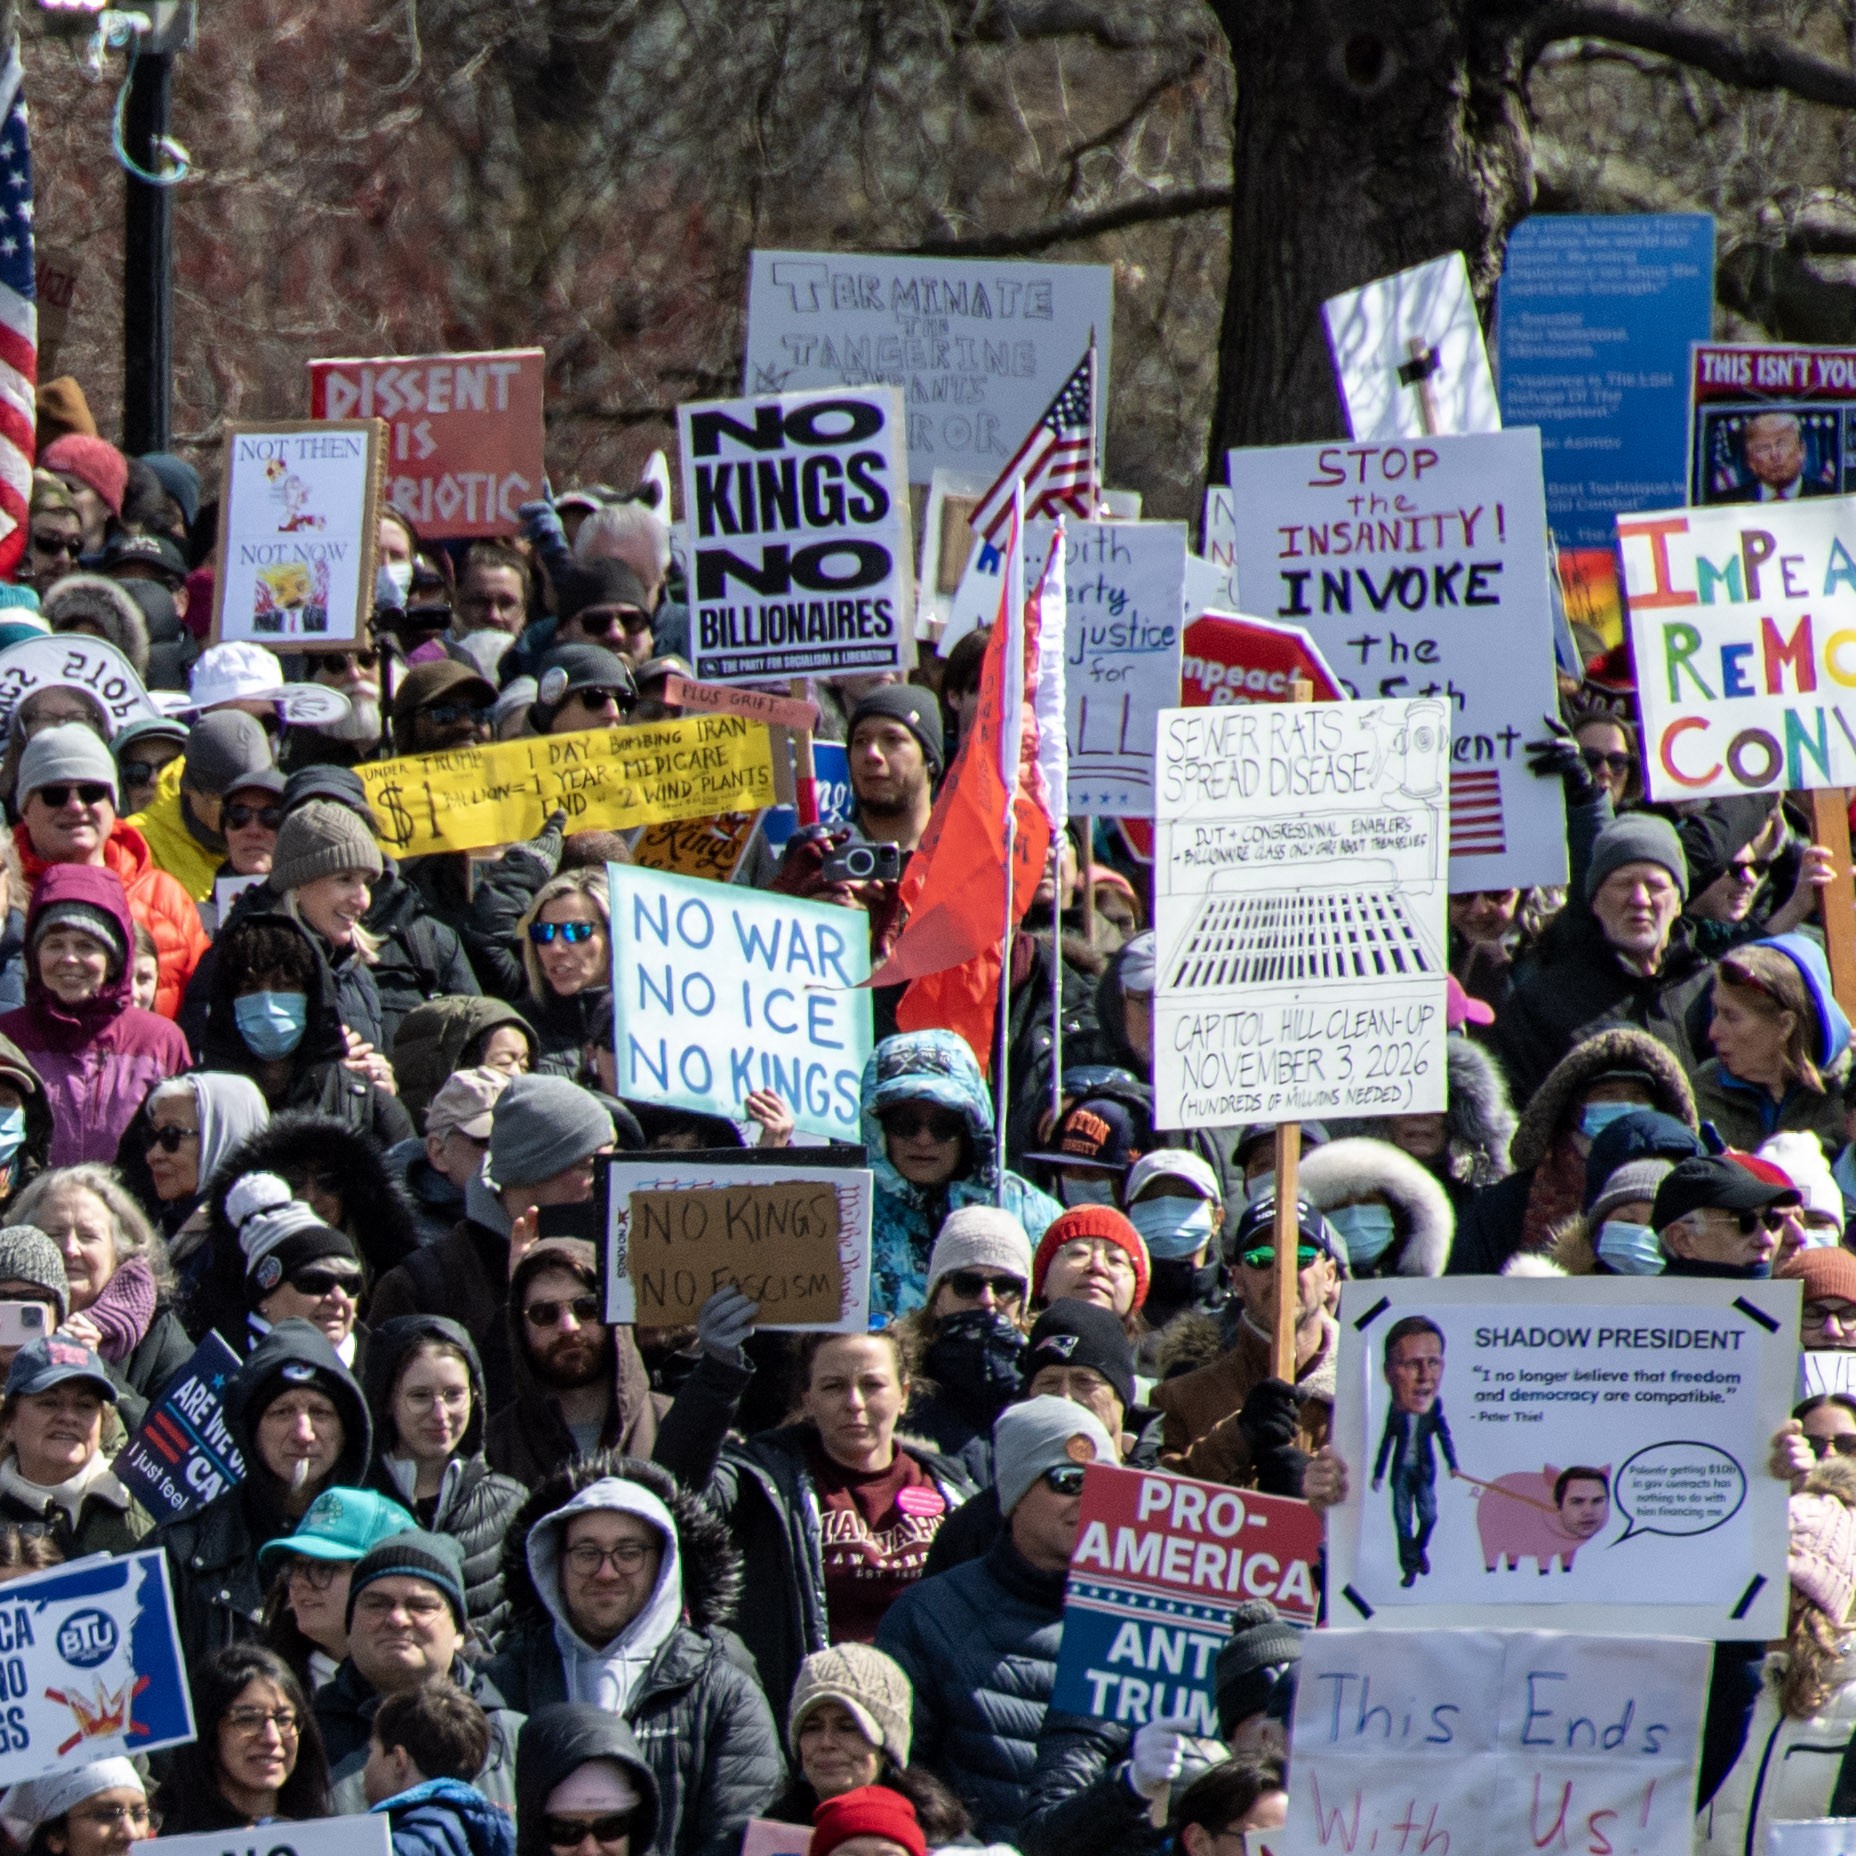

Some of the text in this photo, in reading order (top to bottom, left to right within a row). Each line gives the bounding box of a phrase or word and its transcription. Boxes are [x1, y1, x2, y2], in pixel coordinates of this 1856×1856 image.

[773, 262, 1054, 320] TERMINATE
[326, 361, 521, 419] DISSENT
[1702, 352, 1808, 385] THIS ISN'T
[239, 437, 361, 461] NOT THEN
[397, 420, 438, 460] IS
[690, 400, 886, 458] NO
[1308, 449, 1440, 488] STOP
[694, 452, 891, 538] KINGS
[1347, 490, 1418, 515] the
[240, 543, 350, 565] NOT NOW
[1278, 502, 1507, 559] INSANITY!
[695, 540, 892, 601] NO
[1278, 561, 1505, 618] INVOKE
[699, 599, 893, 651] BILLIONAIRES
[1069, 614, 1176, 665] justice
[1347, 631, 1441, 666] the
[1090, 659, 1137, 683] for
[549, 717, 747, 765] DAY IRAN
[1167, 709, 1344, 764] SEWER RATS
[364, 750, 483, 781] UNDER TRUMP
[553, 745, 729, 792] YEAR MEDICARE
[645, 767, 769, 803] WIND PLANTS
[1164, 758, 1261, 803] SPREAD
[1196, 816, 1413, 847] DJT CONGRESSIONAL ENABLERS
[633, 892, 854, 985] NO WAR
[637, 963, 845, 1049] NO ICE
[1174, 1003, 1435, 1053] CAPITOL HILL CLEAN-UP
[628, 1034, 861, 1126] NO KINGS
[1182, 1039, 1431, 1091] NOVEMBER 2026
[1179, 1078, 1414, 1128] (HUNDREDS OF MILLIONS NEEDED)
[643, 1193, 828, 1244] NO KINGS
[641, 1267, 697, 1307] NO
[1475, 1327, 1746, 1350] SHADOW PRESIDENT
[171, 1374, 217, 1428] ARE
[1475, 1388, 1630, 1405] and democracy are
[1496, 1368, 1741, 1386] no longer believe that freedom
[1137, 1478, 1268, 1537] PRO-
[1076, 1518, 1315, 1605] AMERICA
[61, 1618, 115, 1661] BTU
[1319, 1669, 1671, 1755] This Ends
[1311, 1768, 1655, 1856] With Us!
